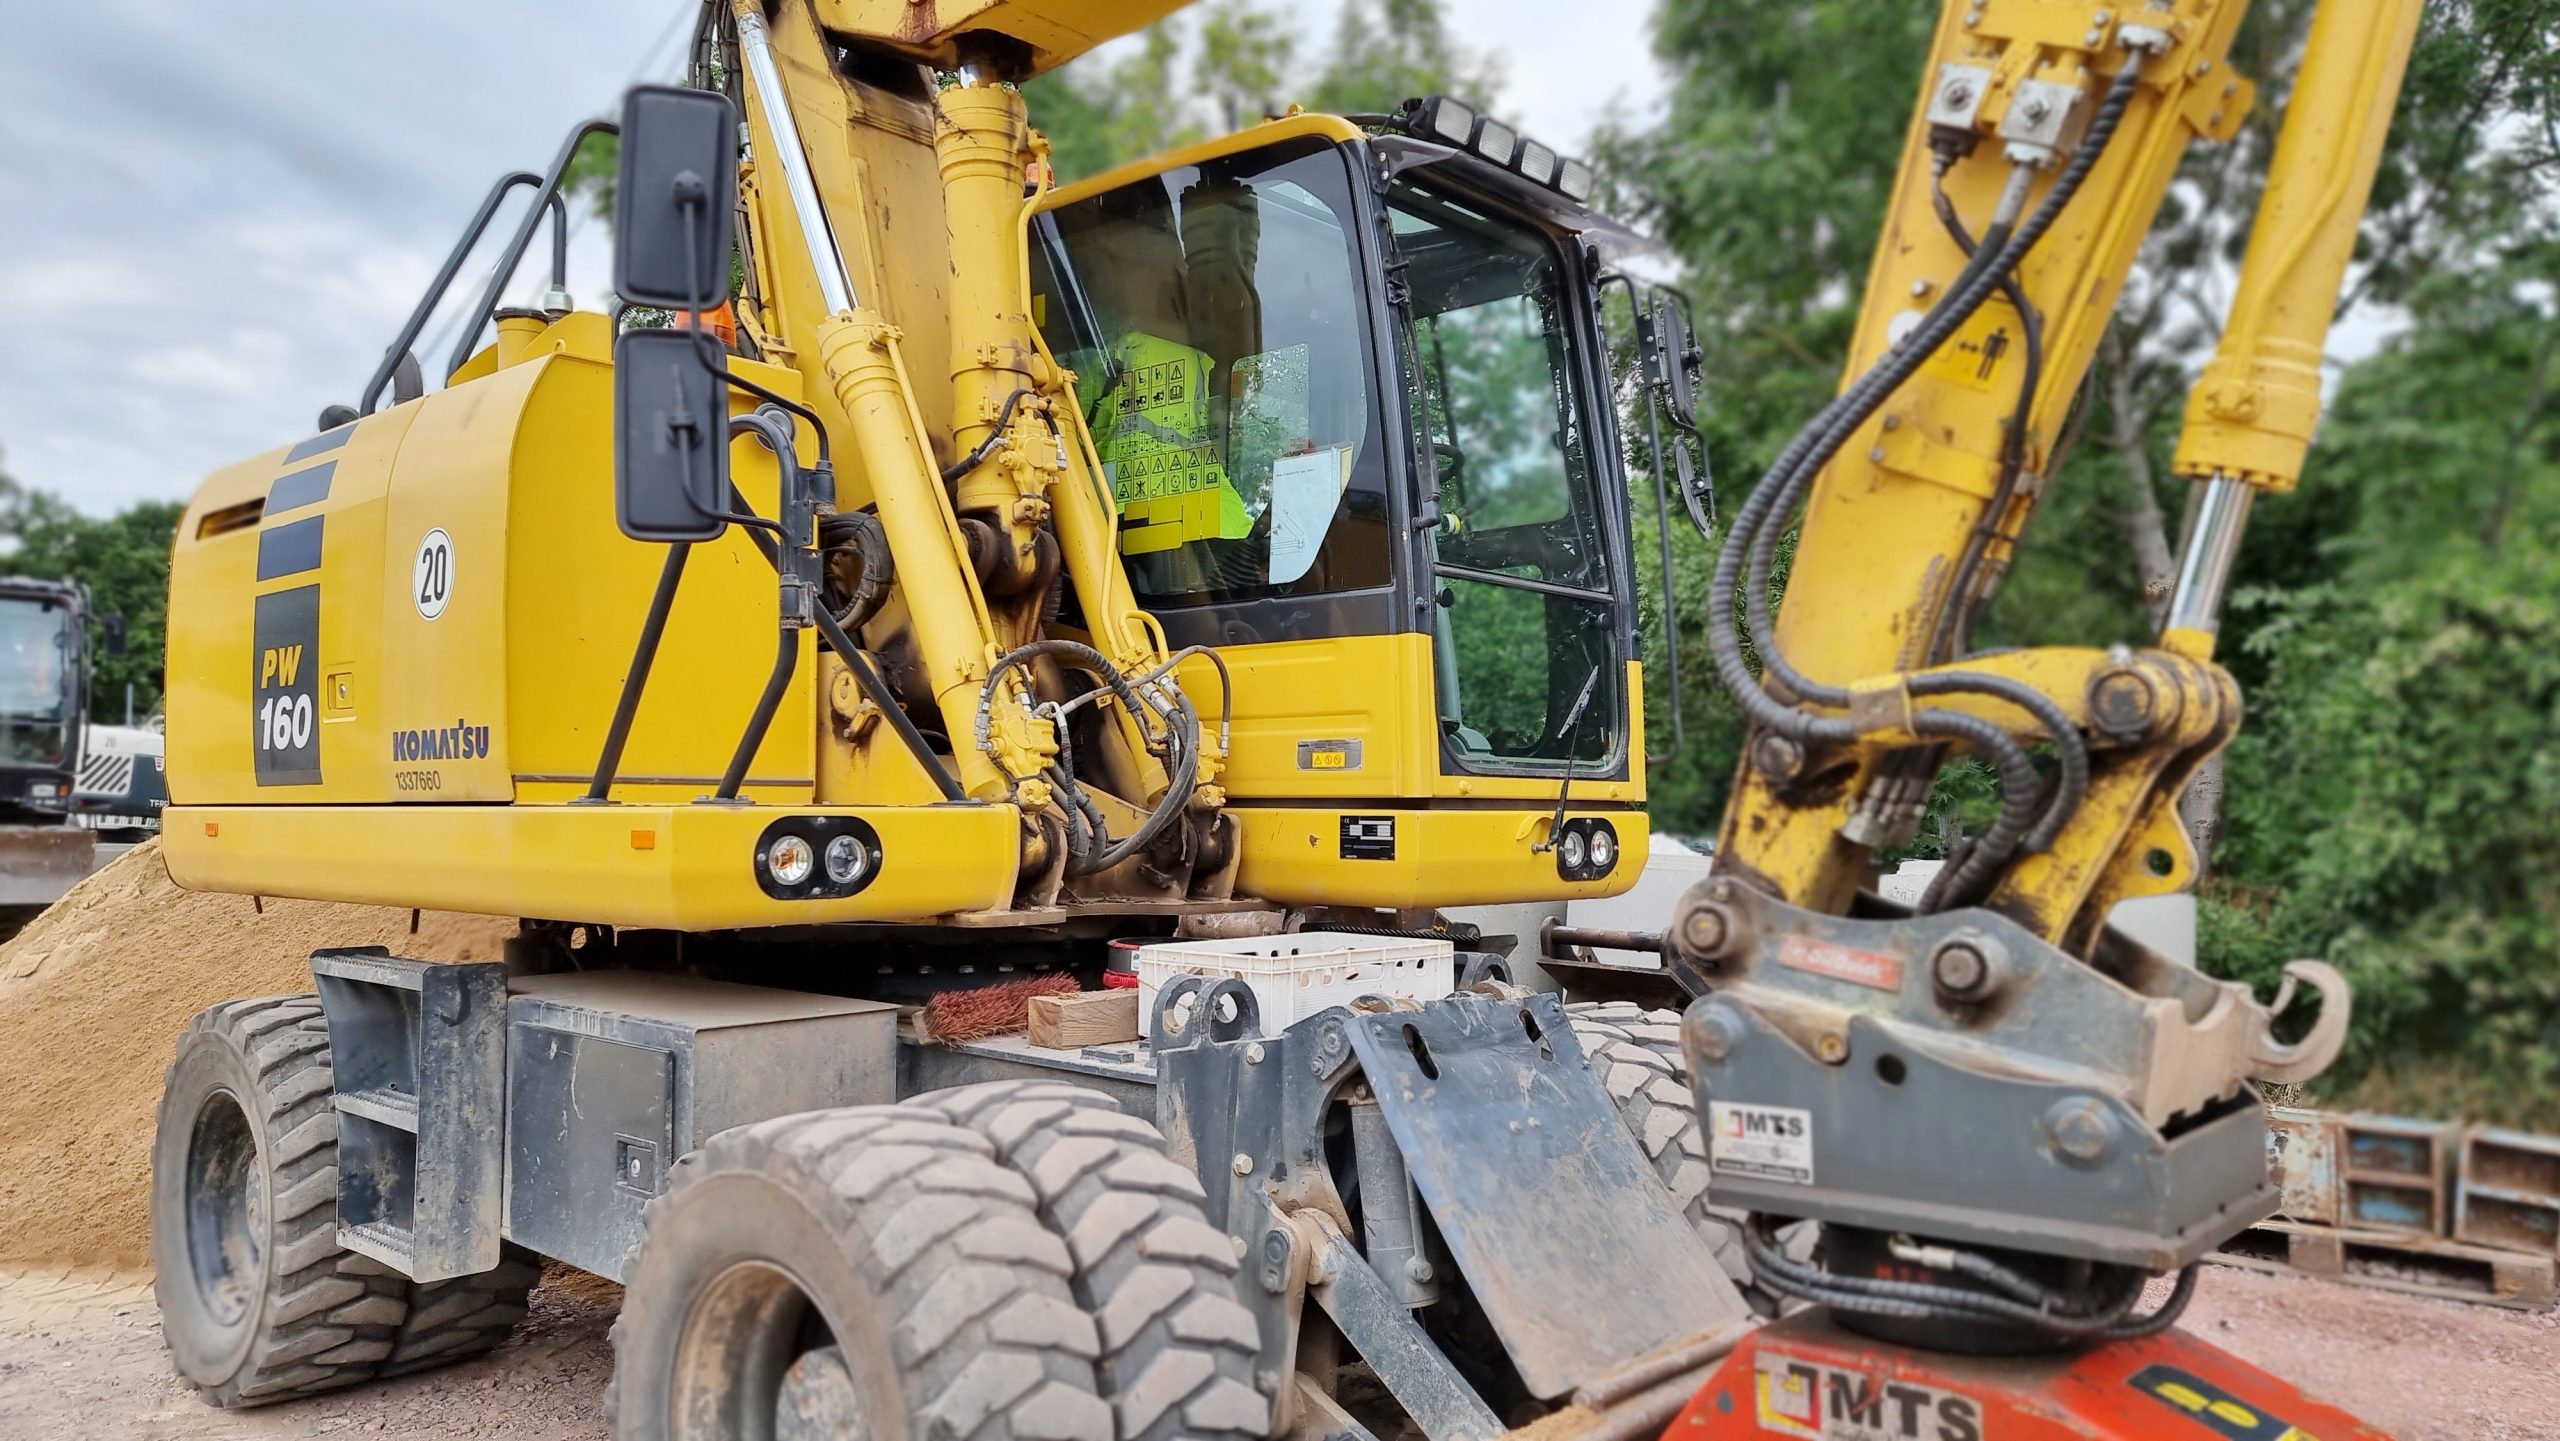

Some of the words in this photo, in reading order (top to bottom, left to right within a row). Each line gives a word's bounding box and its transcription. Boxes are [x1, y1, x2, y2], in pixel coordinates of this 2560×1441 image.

[421, 543, 447, 604] 20
[260, 644, 303, 690] PW
[260, 693, 313, 751] 160
[392, 718, 489, 761] KOMATSU
[395, 770, 441, 791] 1337660
[1746, 1111, 1804, 1138] MTS
[1829, 1371, 1979, 1441] MTS
